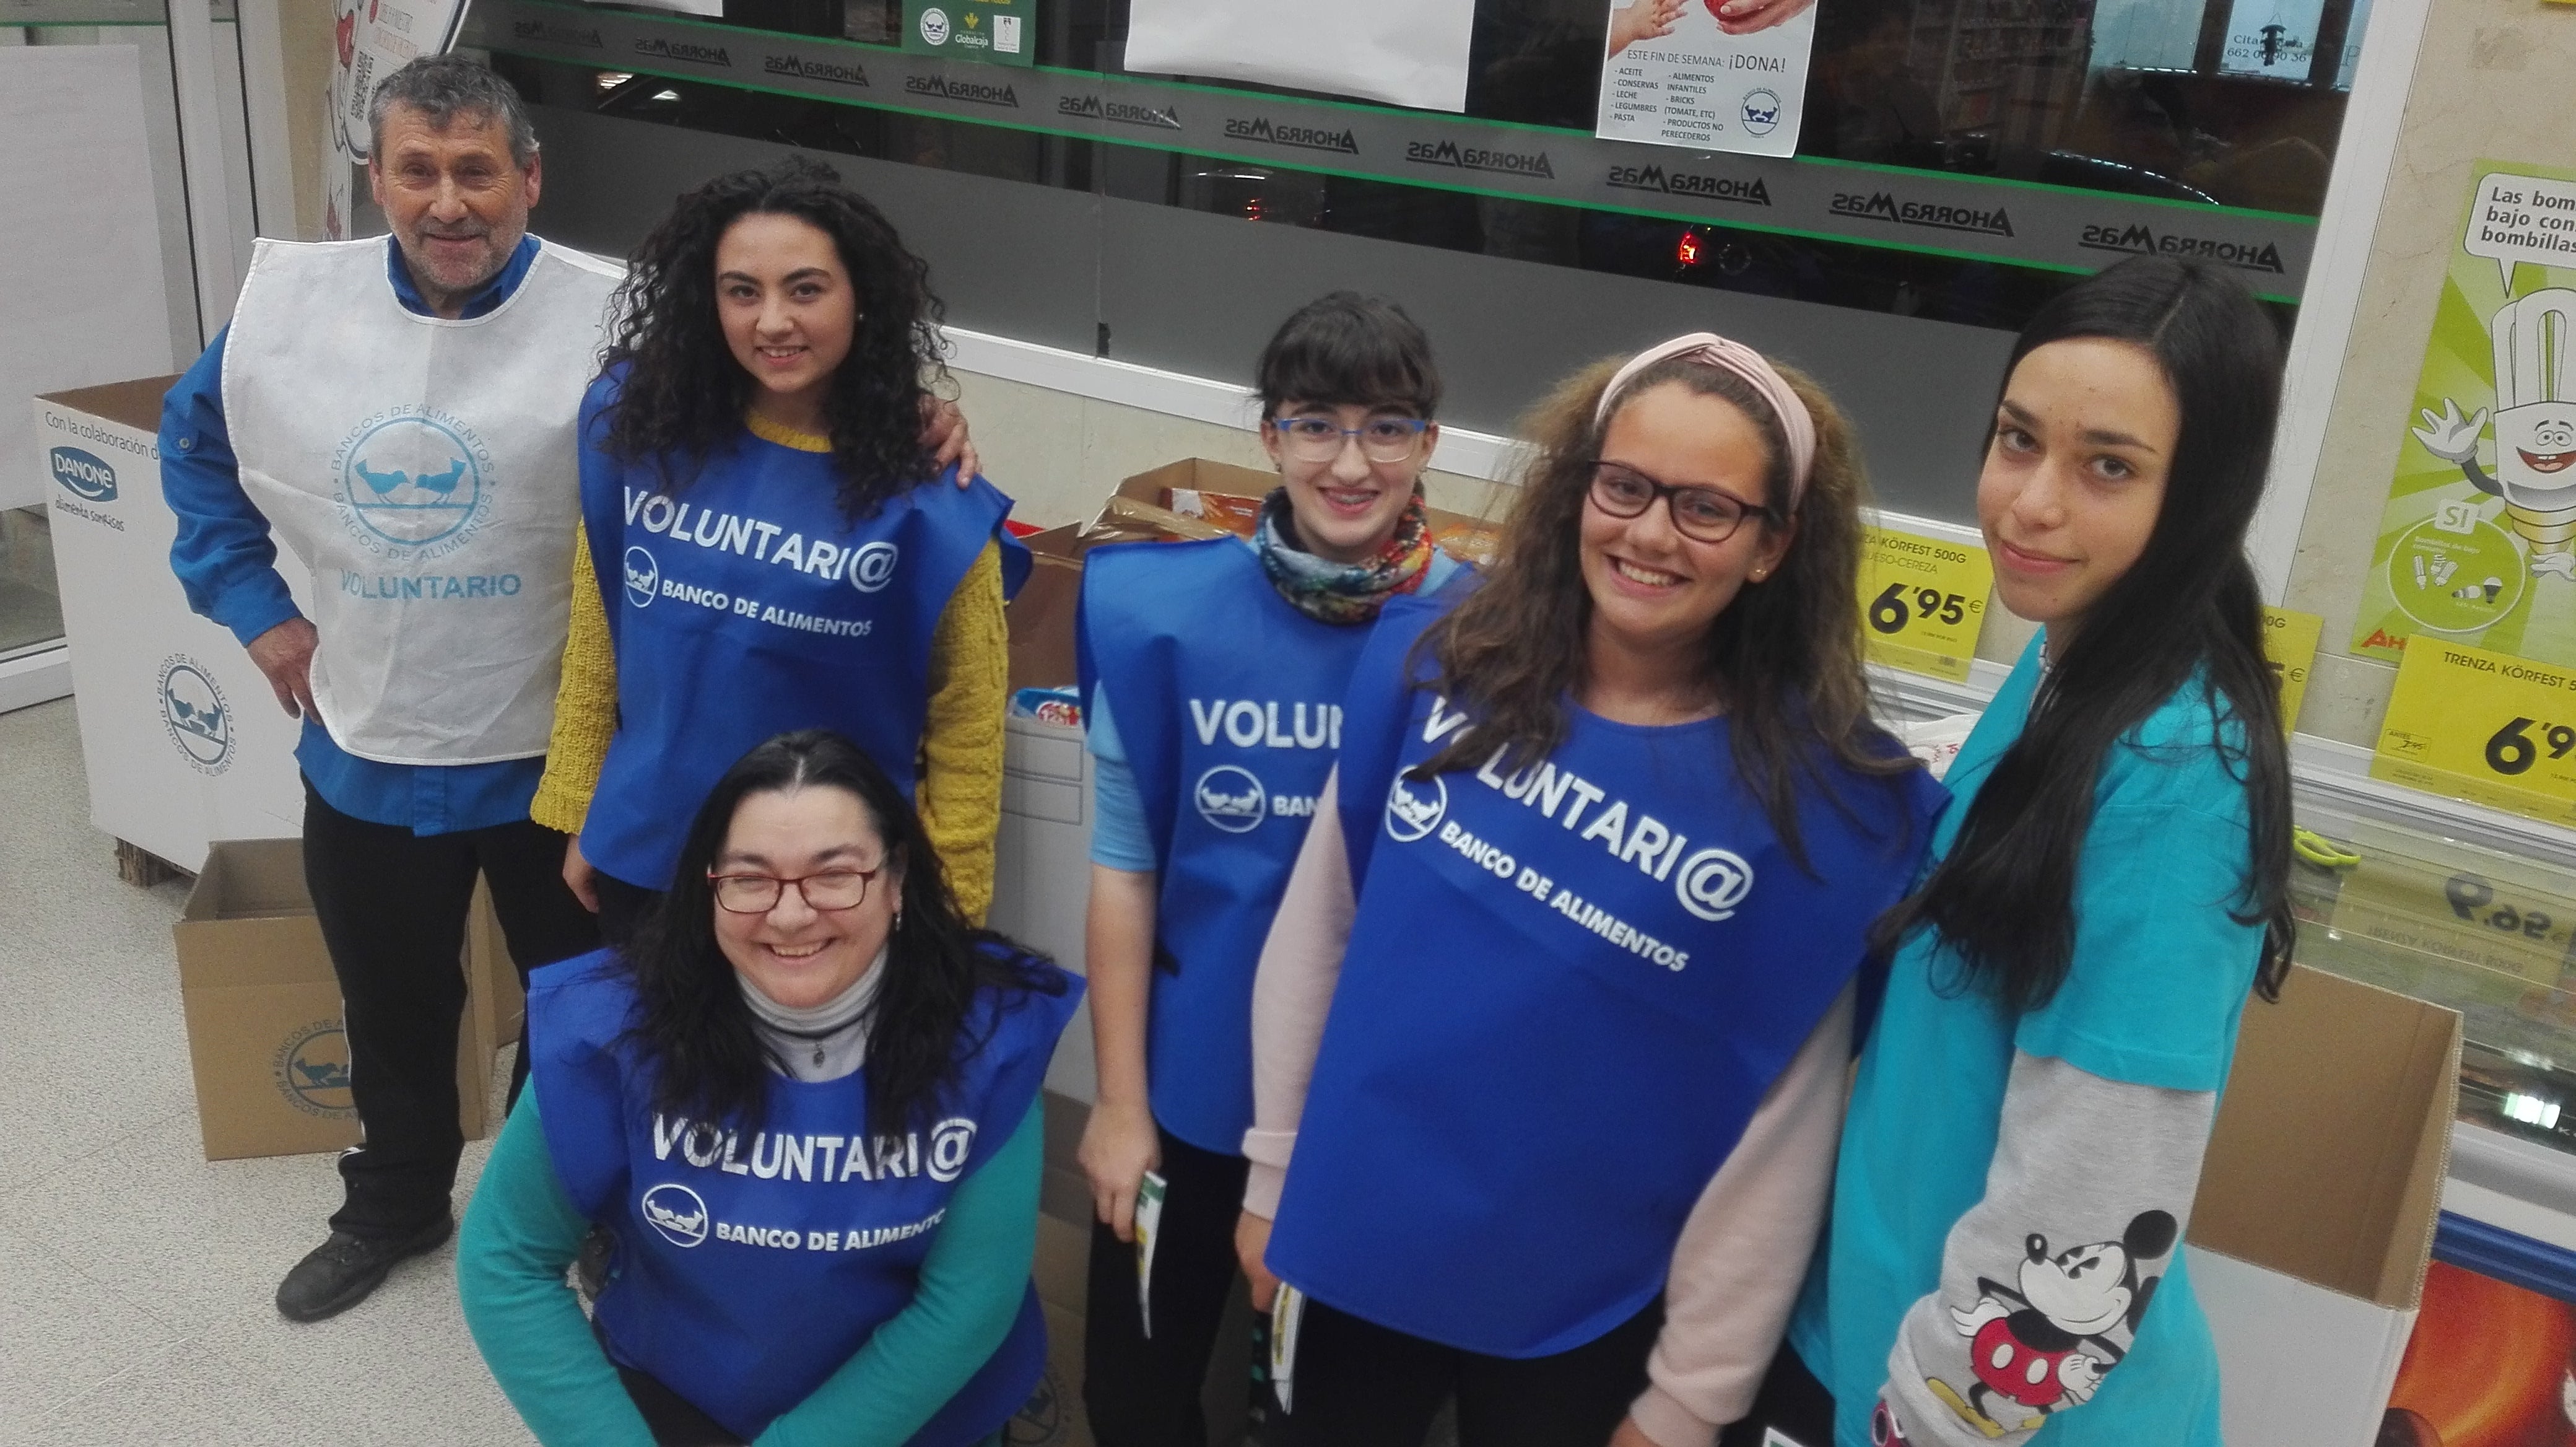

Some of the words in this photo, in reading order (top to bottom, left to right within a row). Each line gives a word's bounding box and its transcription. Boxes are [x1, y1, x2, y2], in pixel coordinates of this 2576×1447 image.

[1628, 50, 1648, 59] ESTE
[1651, 51, 1665, 62] FIN
[1668, 53, 1679, 63] DE
[1682, 54, 1725, 67] SEMANA:
[1730, 54, 1786, 73] ¡DONA!
[1619, 68, 1643, 76] ACEITE
[1673, 72, 1715, 83] ALIMENTOS
[1616, 90, 1637, 99] LECHE
[1617, 79, 1659, 90] CONSERVAS
[1667, 84, 1707, 94] INFANTILES
[1615, 102, 1657, 113] LEGUMBRES
[1671, 95, 1695, 105] BRICKS
[1614, 113, 1635, 122] PASTA
[1664, 107, 1698, 118] (TOMATE,
[1700, 110, 1715, 120] ETC)
[1661, 129, 1710, 141] PERECEDEROS
[1667, 119, 1710, 130] PRODUCTOS
[1712, 123, 1723, 131] NO
[2492, 187, 2523, 204] Las
[2486, 206, 2531, 229] bajo
[46, 411, 66, 431] Con
[68, 417, 79, 435] la
[80, 424, 149, 457] colaboración
[331, 412, 385, 471] BANCOS
[390, 404, 412, 416] DE
[416, 404, 495, 473] ALIMENTOS
[624, 486, 899, 593] VOLUNTARI@
[388, 549, 412, 561] DE
[1881, 537, 1932, 556] KÖRFEST
[1934, 549, 1967, 564] 500G
[341, 568, 522, 600] VOLUNTARIO
[662, 579, 729, 610] BANCO
[733, 597, 760, 619] DE
[760, 606, 873, 637] ALIMENTOS
[2445, 651, 2497, 673] TRENZA
[2502, 665, 2567, 688] KÖRFEST
[1422, 695, 1754, 922] VLUNTARI@
[1439, 820, 1516, 879] BANCO
[1516, 867, 1553, 901] DE
[1550, 890, 1690, 971] ALIMENTOS
[652, 1114, 978, 1183] VOLUNTARI@
[716, 1223, 801, 1250] BANCO
[807, 1232, 838, 1252] DE
